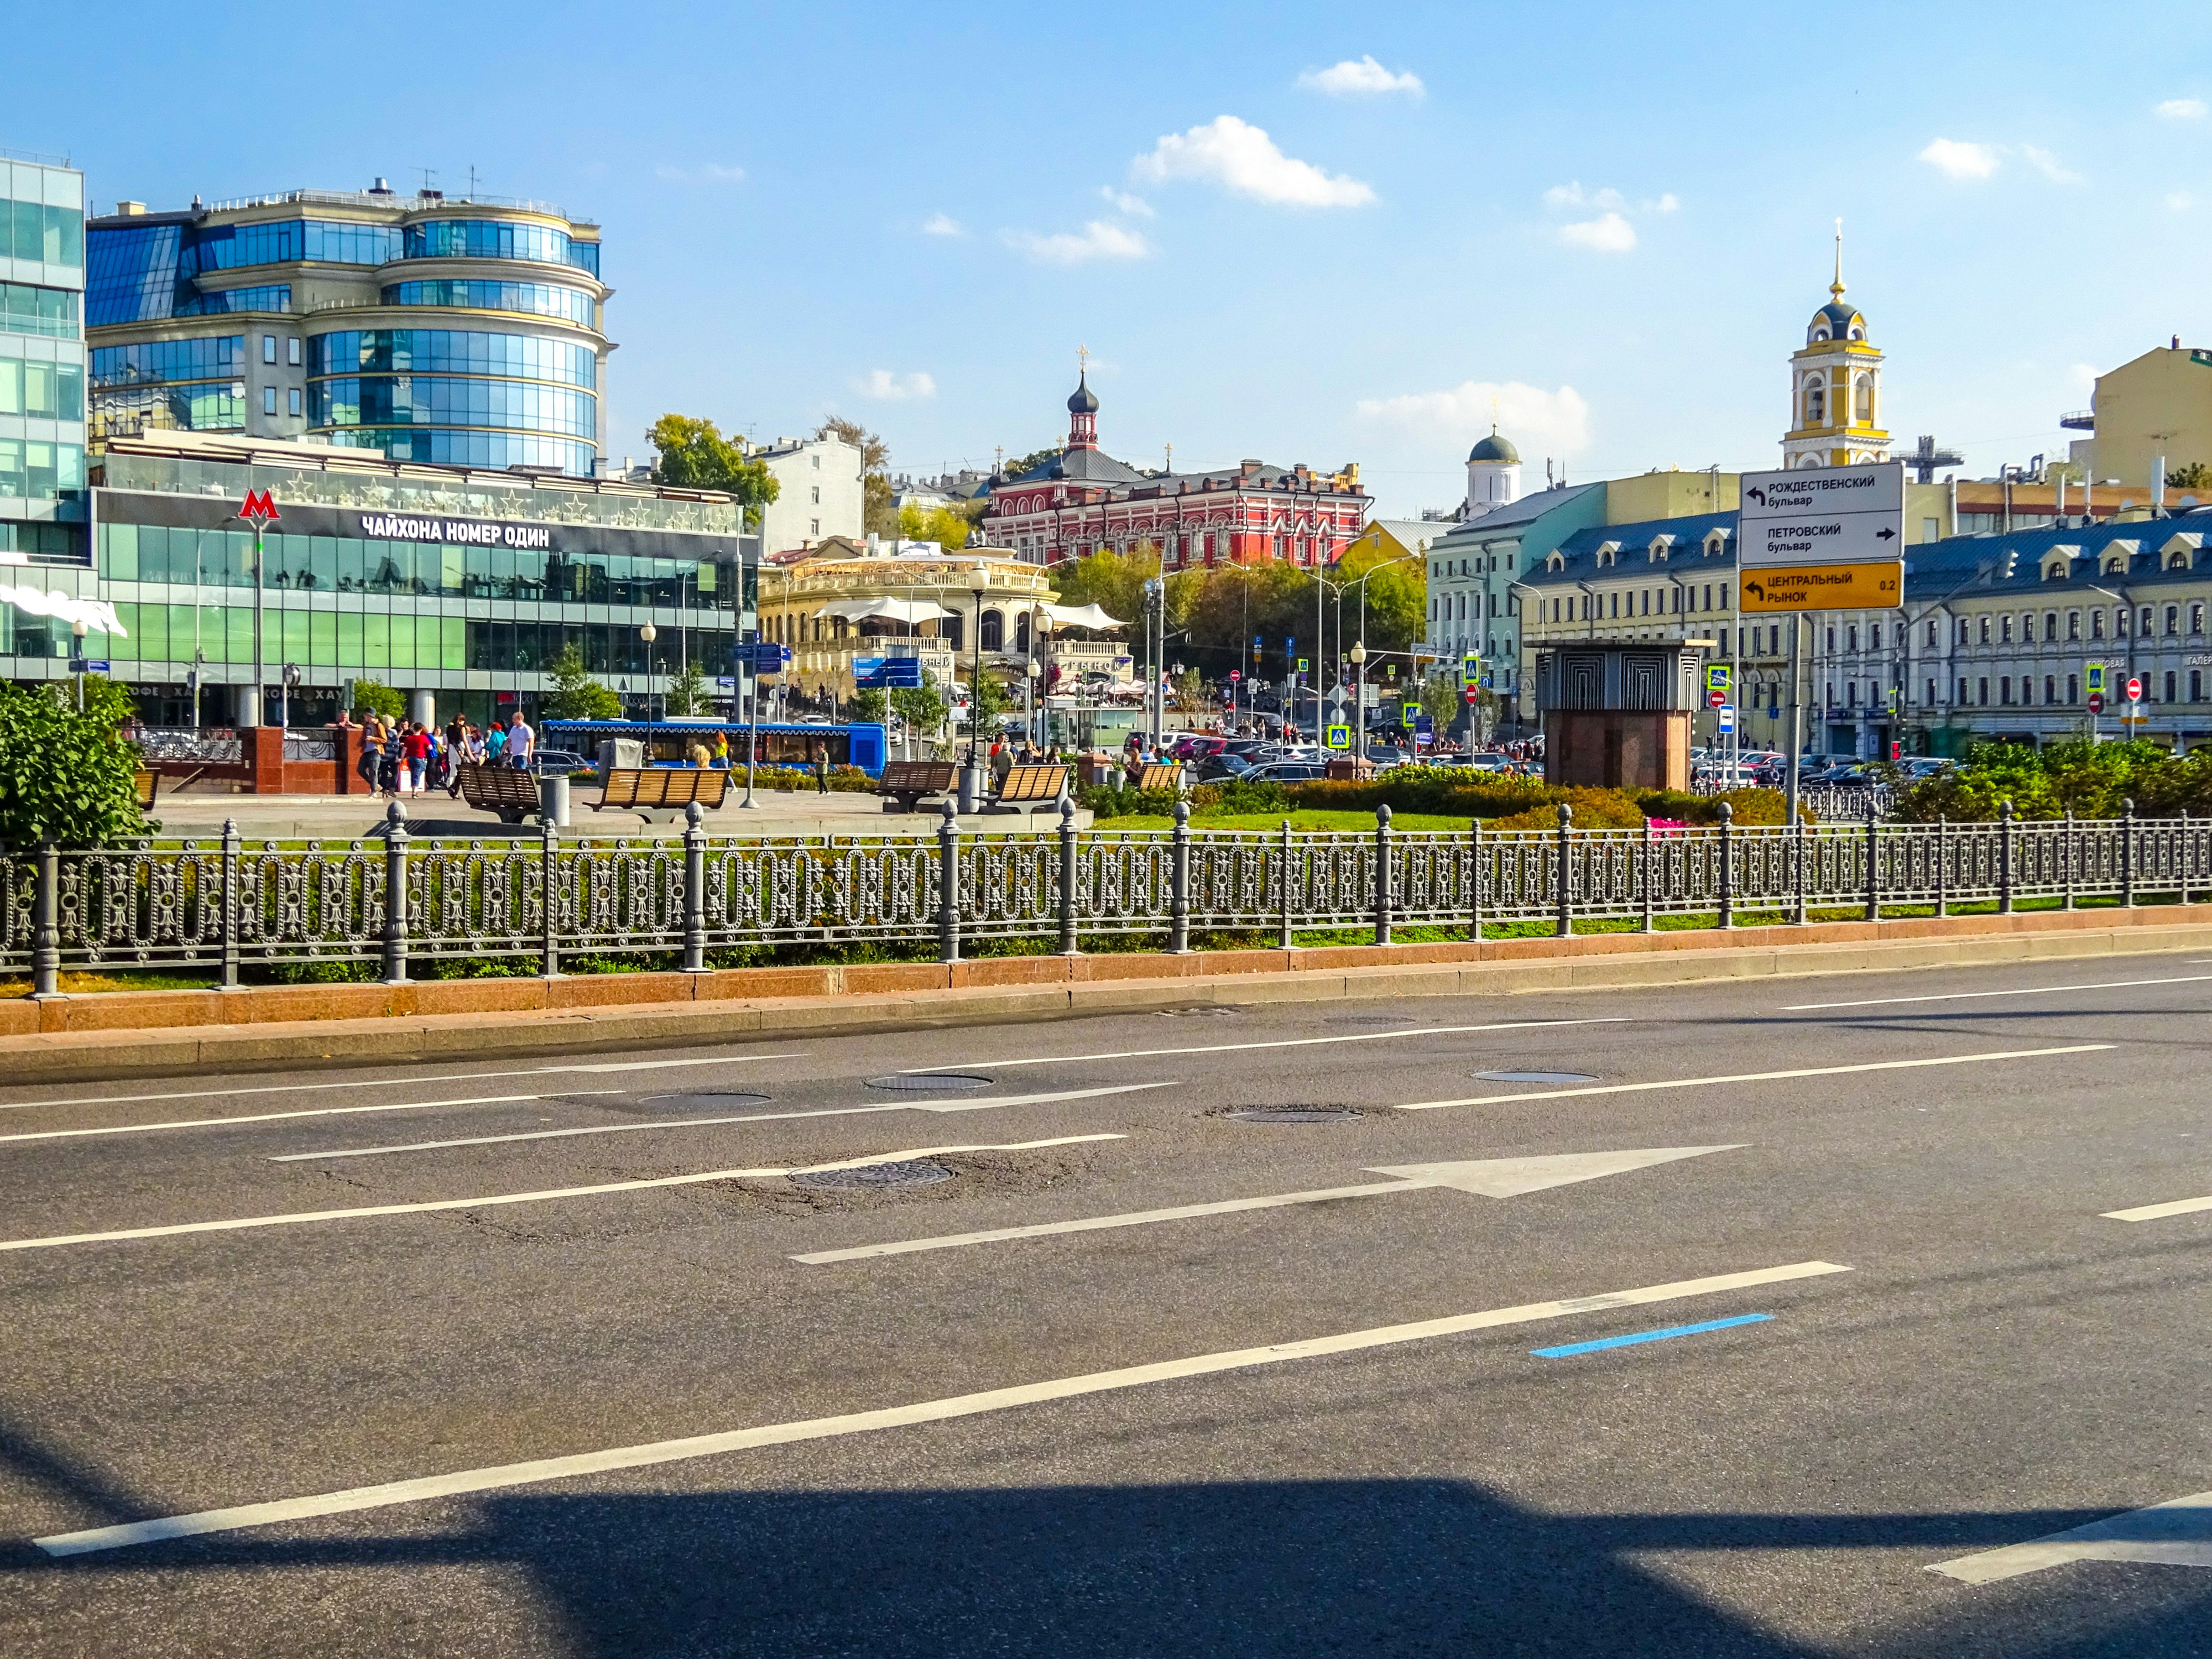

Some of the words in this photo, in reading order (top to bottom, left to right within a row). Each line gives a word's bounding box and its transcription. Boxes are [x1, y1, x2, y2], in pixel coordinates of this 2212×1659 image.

[1769, 475, 1875, 493] РОЖДЕСТВЕНСКИЙ
[1768, 497, 1812, 509] бульвар
[362, 514, 442, 540] ЧАЙХОНА
[446, 522, 501, 544] НОМЕР
[505, 526, 549, 547] ОДИН
[1768, 523, 1841, 538] ПЕТРОВСКИЙ
[1768, 542, 1812, 554] бульвар
[1768, 572, 1853, 588] ЦЕНТРАЛЬНЫЙ
[1880, 580, 1895, 591] 0.2
[1767, 592, 1807, 603] РЫНОК
[922, 656, 950, 666] ЬНЫЙ
[1071, 661, 1120, 670] РЫНОК
[130, 687, 159, 696] ОФЕ
[174, 687, 210, 697] ХАЗ
[315, 690, 345, 700] ХАУ
